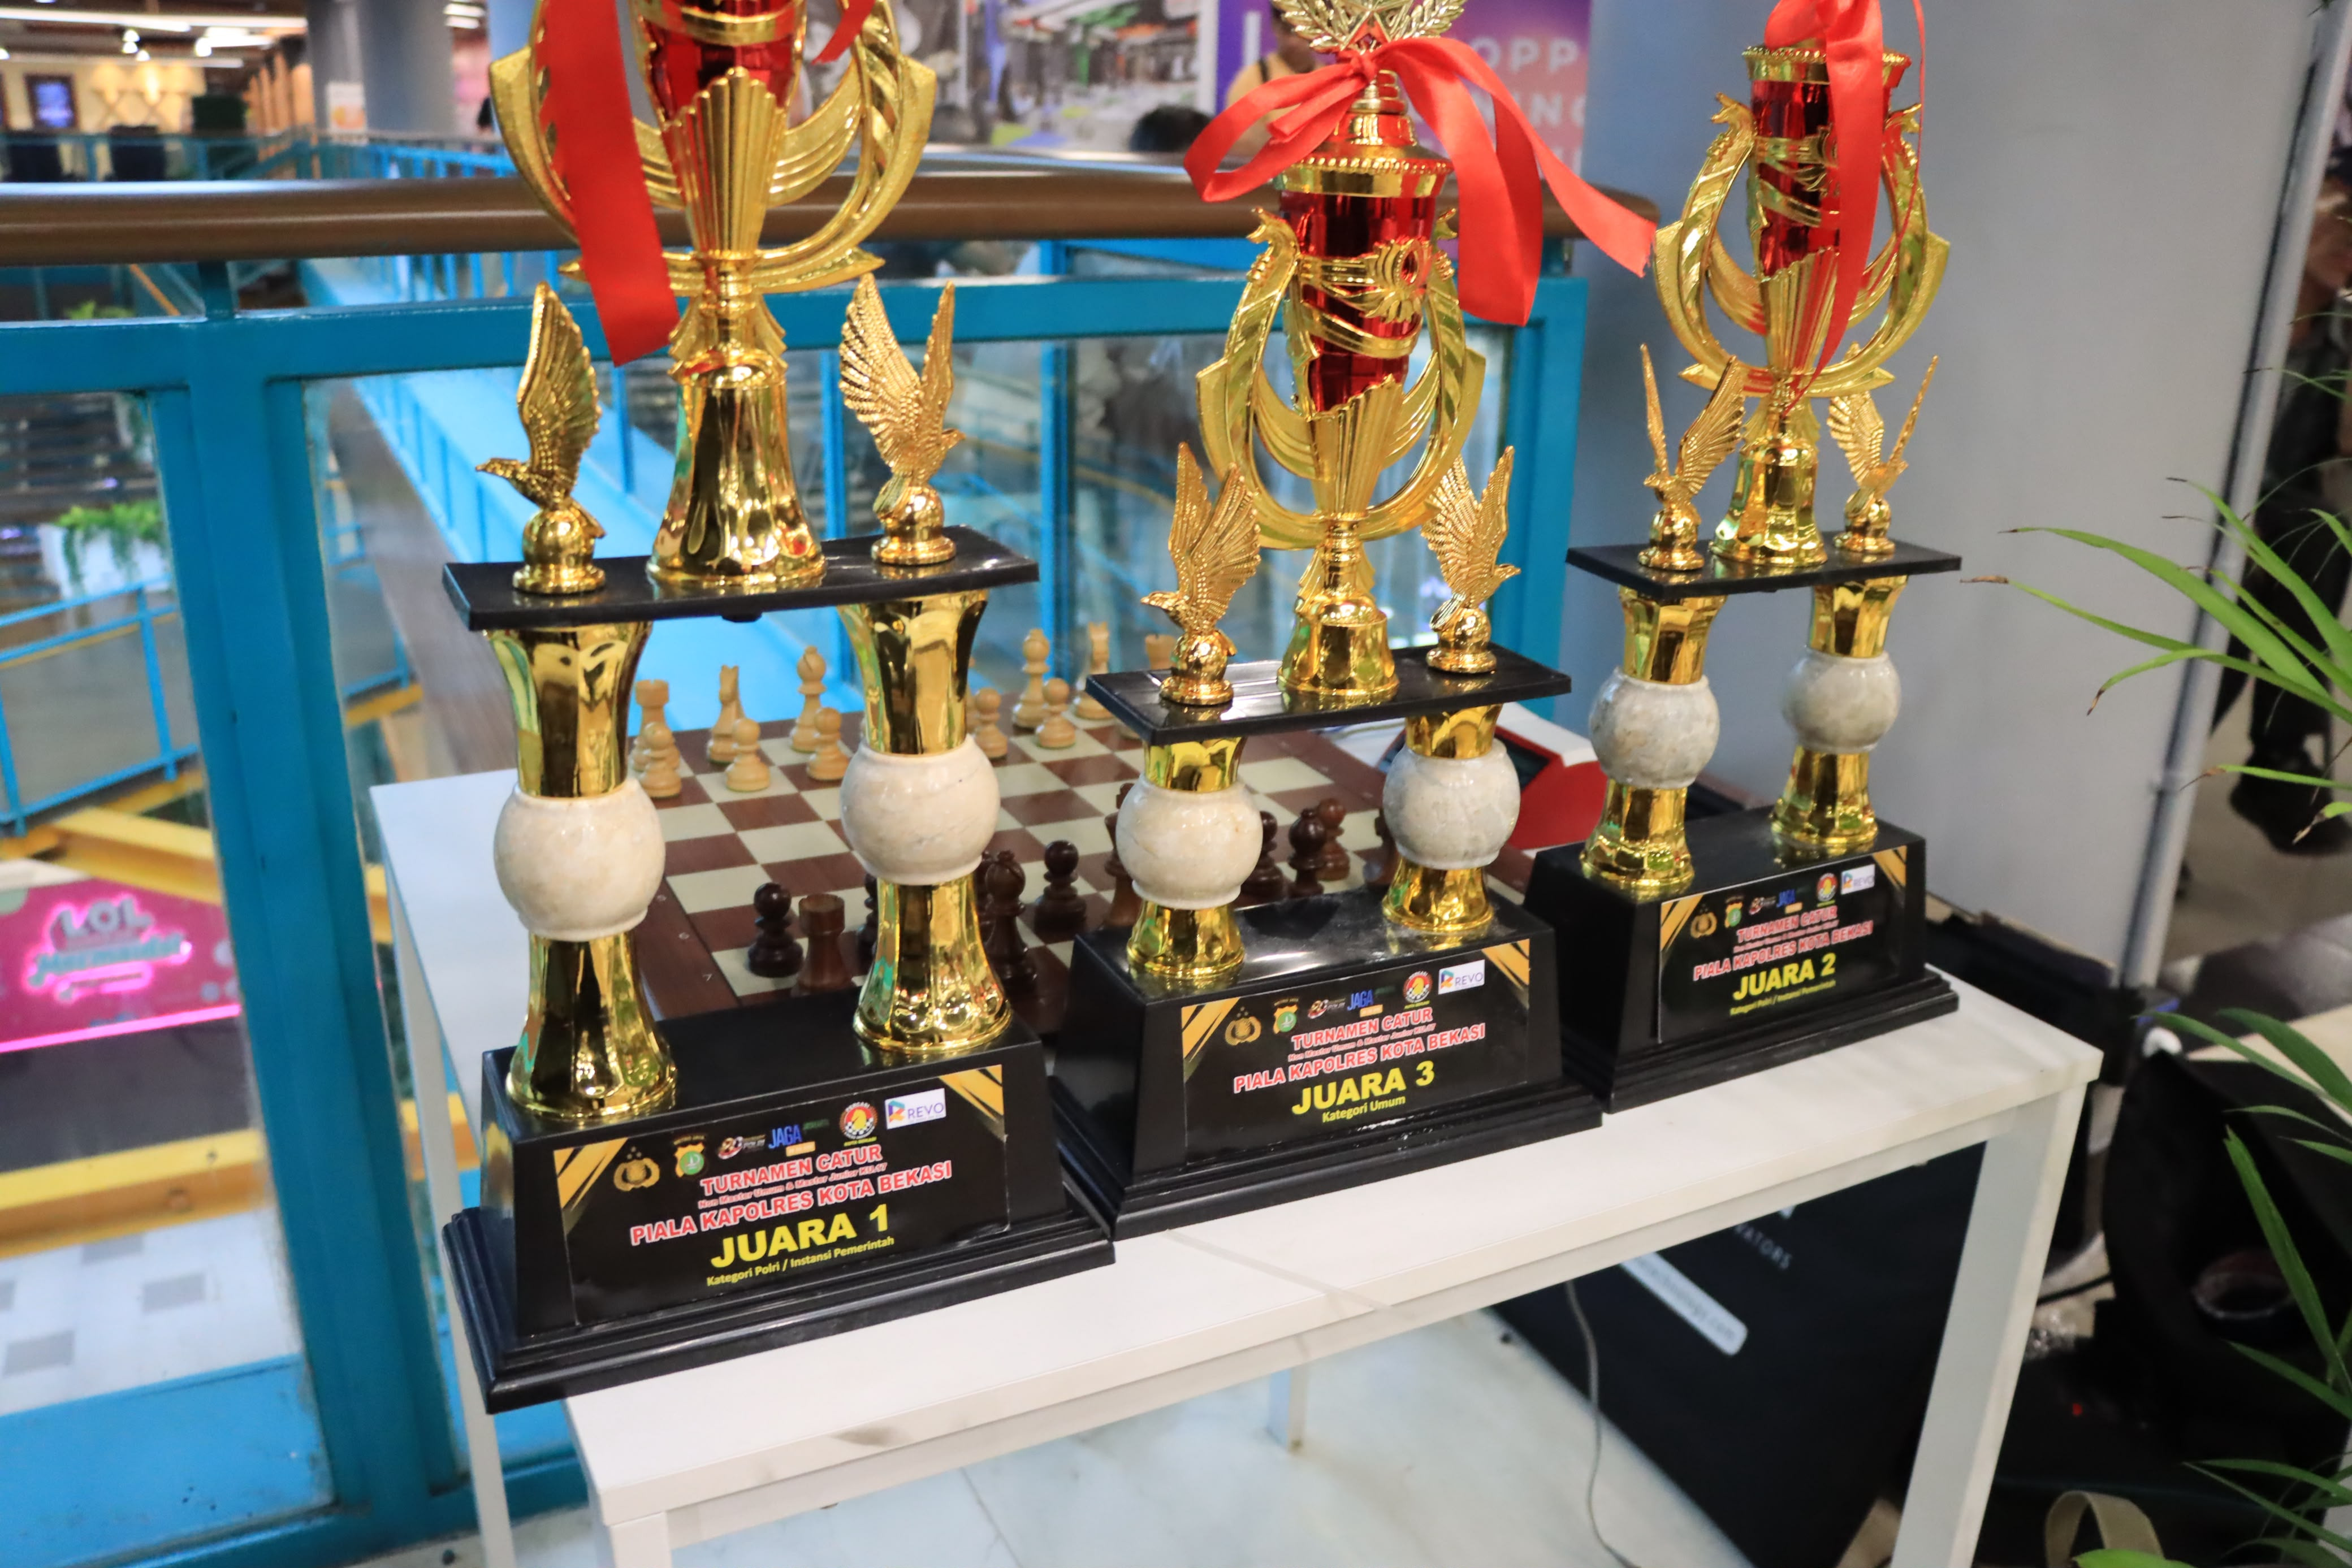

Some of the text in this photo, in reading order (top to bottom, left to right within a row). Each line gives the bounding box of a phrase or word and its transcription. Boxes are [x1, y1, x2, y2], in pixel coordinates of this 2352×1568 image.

[1736, 915, 1800, 943] TURNAMEN
[1800, 905, 1838, 927] CATUR
[1693, 958, 1732, 981] PIALA
[1733, 941, 1797, 971] KAPOLRES
[1798, 932, 1830, 954] KOTA
[1831, 920, 1874, 945] BEKASI
[1455, 972, 1484, 987] REVO
[1733, 952, 1836, 1000] JUARA 2
[1291, 1018, 1380, 1051] TURNAMEN
[1382, 1007, 1433, 1031] CATUR
[1234, 1023, 1486, 1094] PIALA KAPOLRES KOTA BEKASI
[907, 1102, 944, 1119] REVO
[1292, 1060, 1435, 1115] JUARA 3
[1322, 1095, 1406, 1123] Kategori Umum
[768, 1124, 802, 1149] JAGA
[700, 1157, 812, 1197] TURNAMEN
[816, 1144, 883, 1172] CATUR
[719, 1192, 753, 1205] Master
[794, 1175, 828, 1189] Master
[630, 1160, 952, 1246] PIALA KAPOLRES KOTA BEKASI
[711, 1203, 888, 1268] JUARA 1
[707, 1236, 895, 1287] Kategori Polri / Instansi Pemerintah
